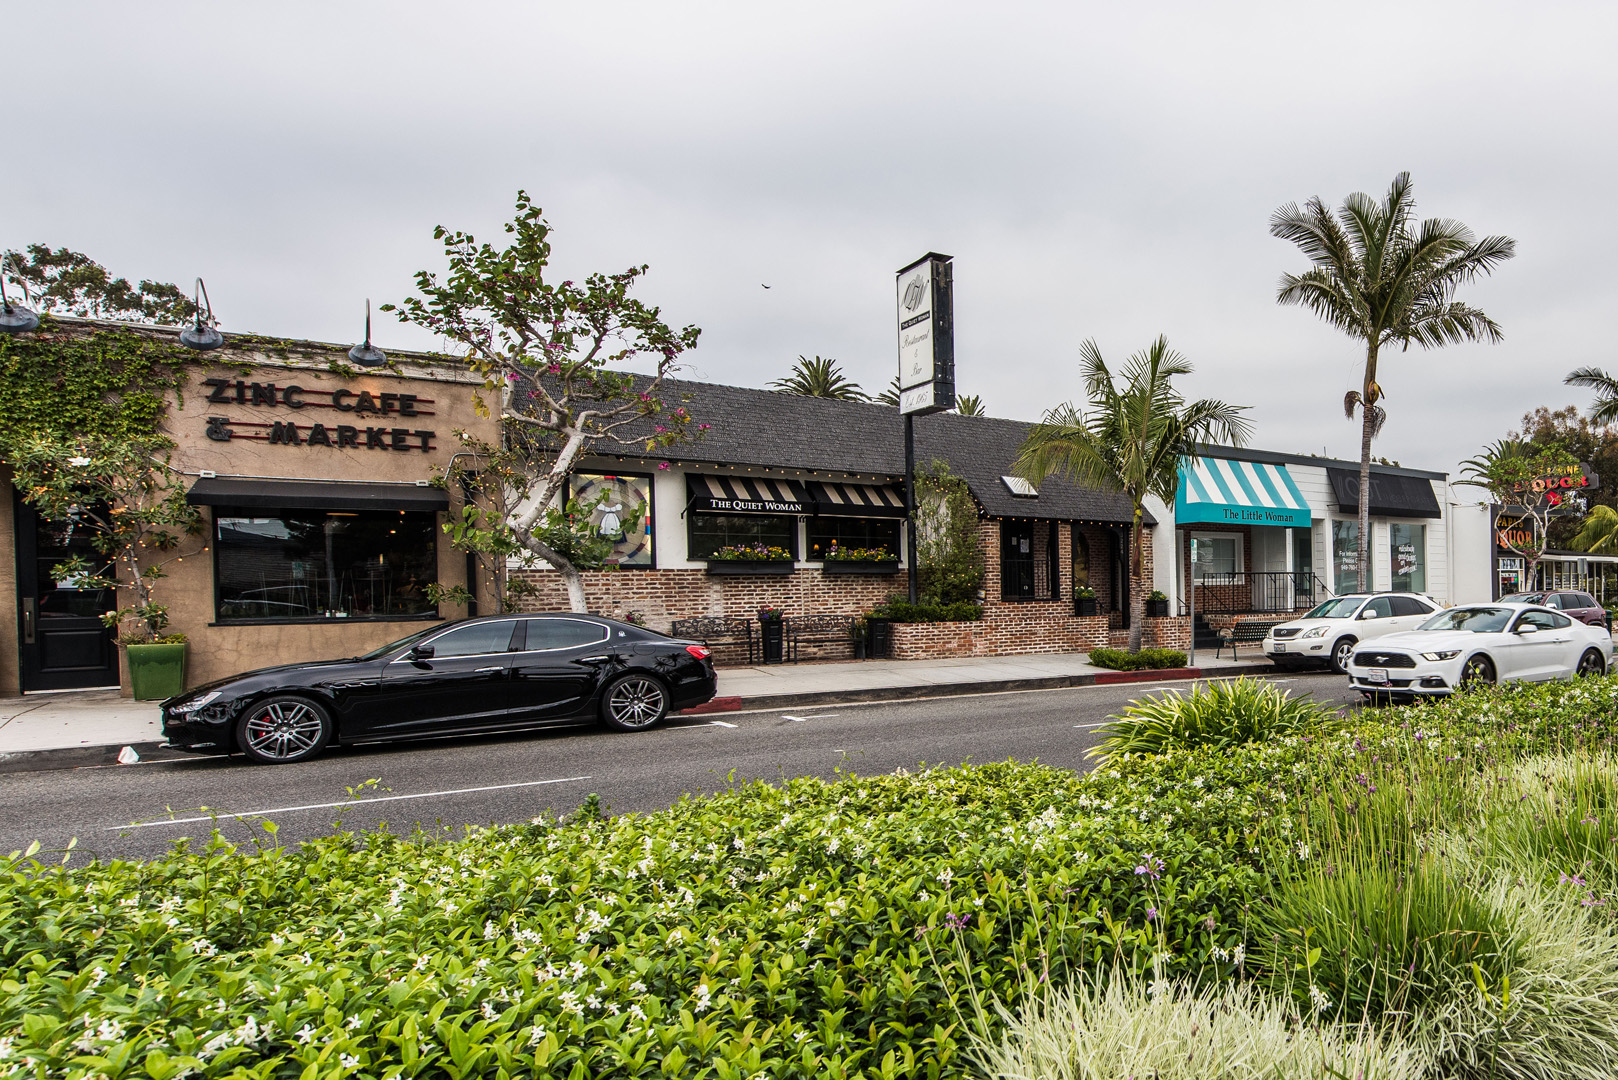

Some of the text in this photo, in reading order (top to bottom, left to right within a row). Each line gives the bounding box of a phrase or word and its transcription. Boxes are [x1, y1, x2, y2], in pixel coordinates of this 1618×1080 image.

[910, 318, 918, 326] QUIET
[918, 313, 930, 323] WOMAN
[901, 329, 930, 349] Restaurant
[910, 362, 922, 377] Bar
[206, 378, 418, 416] ZINC CAFE
[206, 416, 436, 453] & MARKET
[1222, 508, 1294, 522] The Little Woman
